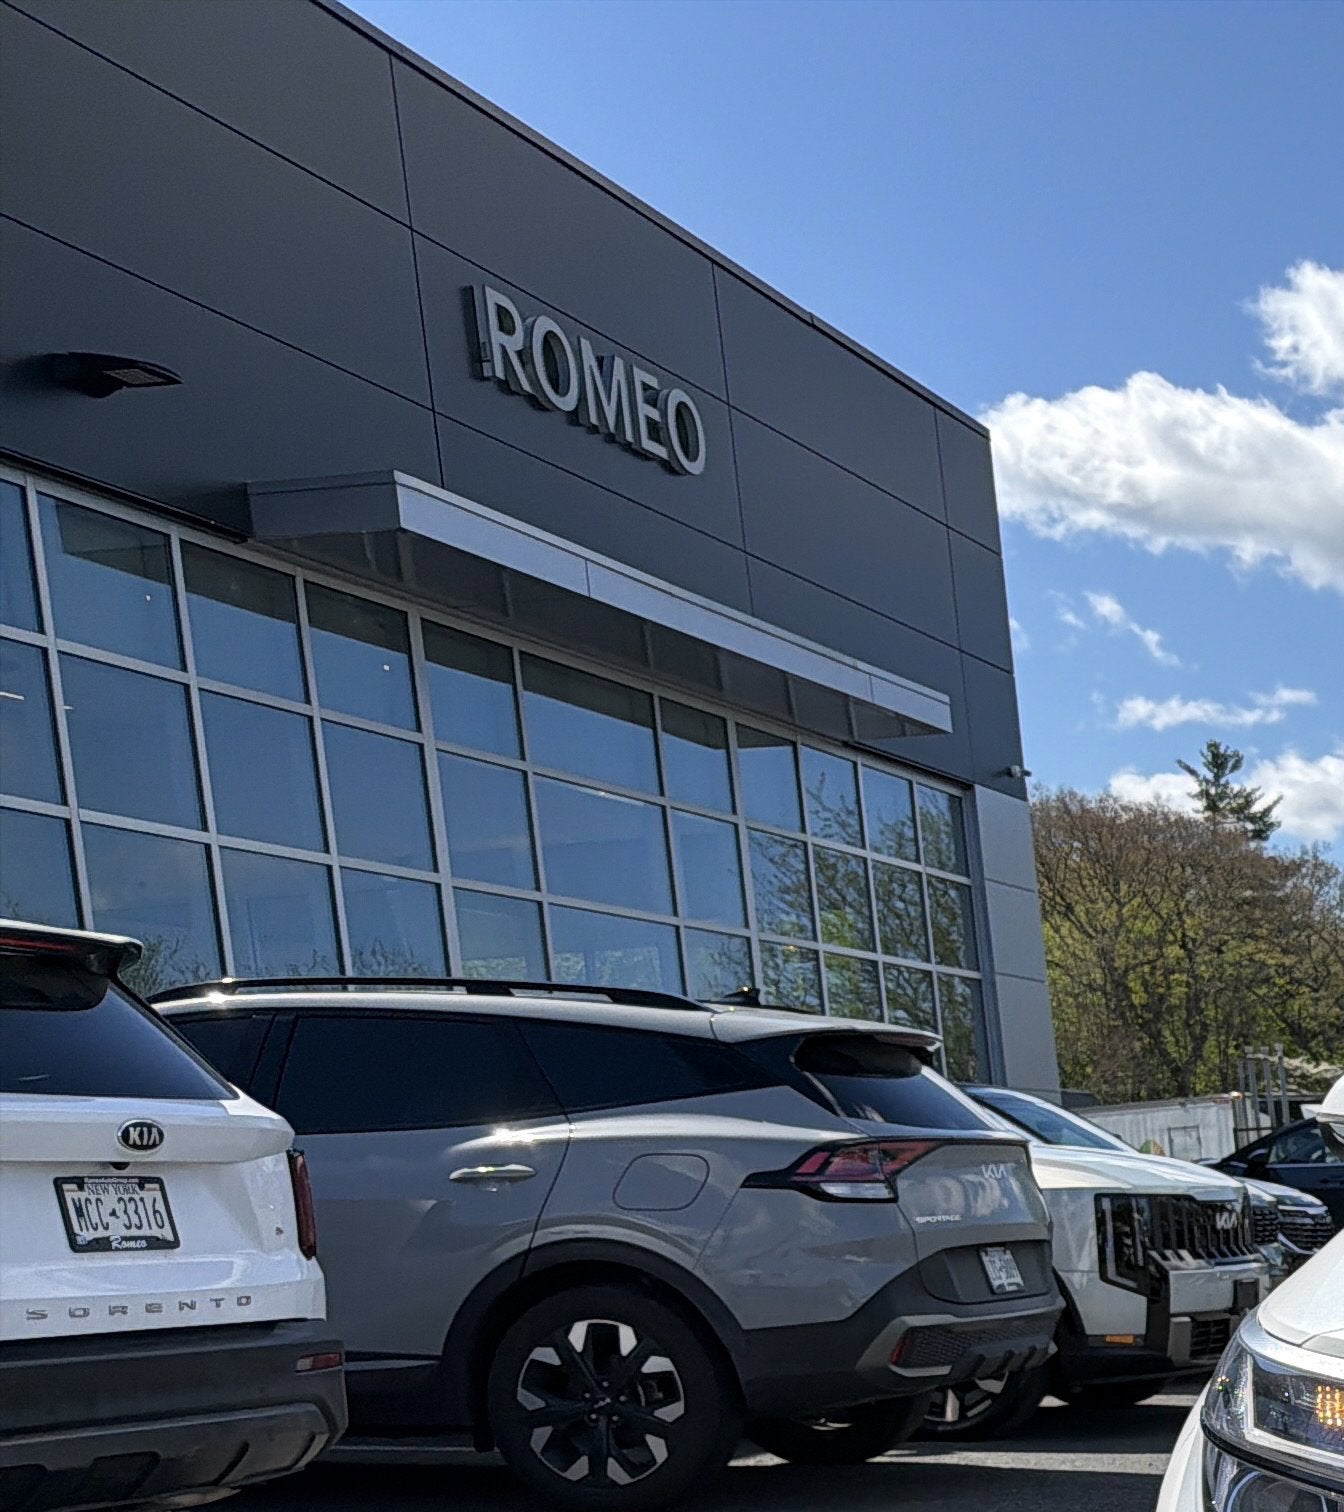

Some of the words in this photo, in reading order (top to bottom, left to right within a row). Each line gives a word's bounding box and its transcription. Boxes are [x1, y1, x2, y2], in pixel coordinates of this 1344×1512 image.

[476, 284, 706, 476] ROMEO
[128, 1126, 160, 1146] KIA
[87, 1184, 110, 1195] NEW
[112, 1184, 140, 1195] YORK
[109, 1235, 148, 1249] Romeo
[26, 1295, 252, 1321] SORENTO
